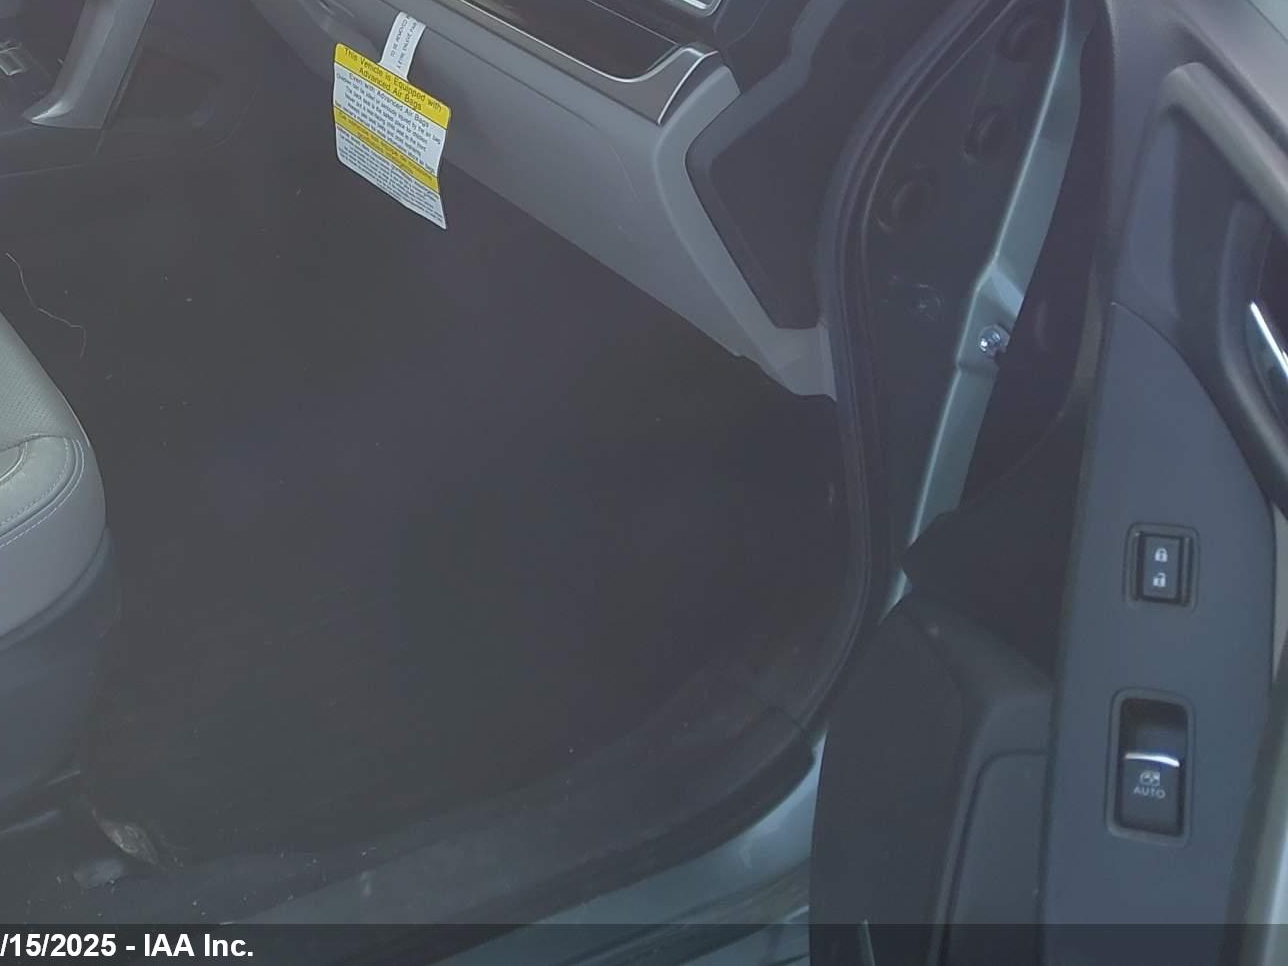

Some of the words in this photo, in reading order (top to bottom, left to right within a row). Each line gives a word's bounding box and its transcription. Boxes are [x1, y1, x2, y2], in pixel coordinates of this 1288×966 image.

[344, 47, 357, 62] This
[360, 56, 383, 77] Vehicle
[393, 76, 425, 104] Equipped
[427, 97, 441, 113] with
[348, 71, 362, 86] Even
[364, 81, 375, 93] with
[376, 88, 403, 112] Advanced
[414, 112, 429, 130] Bags
[359, 66, 390, 91] Advanced
[392, 86, 401, 98] Air
[404, 92, 421, 112] Bags
[1133, 786, 1166, 800] AUTO
